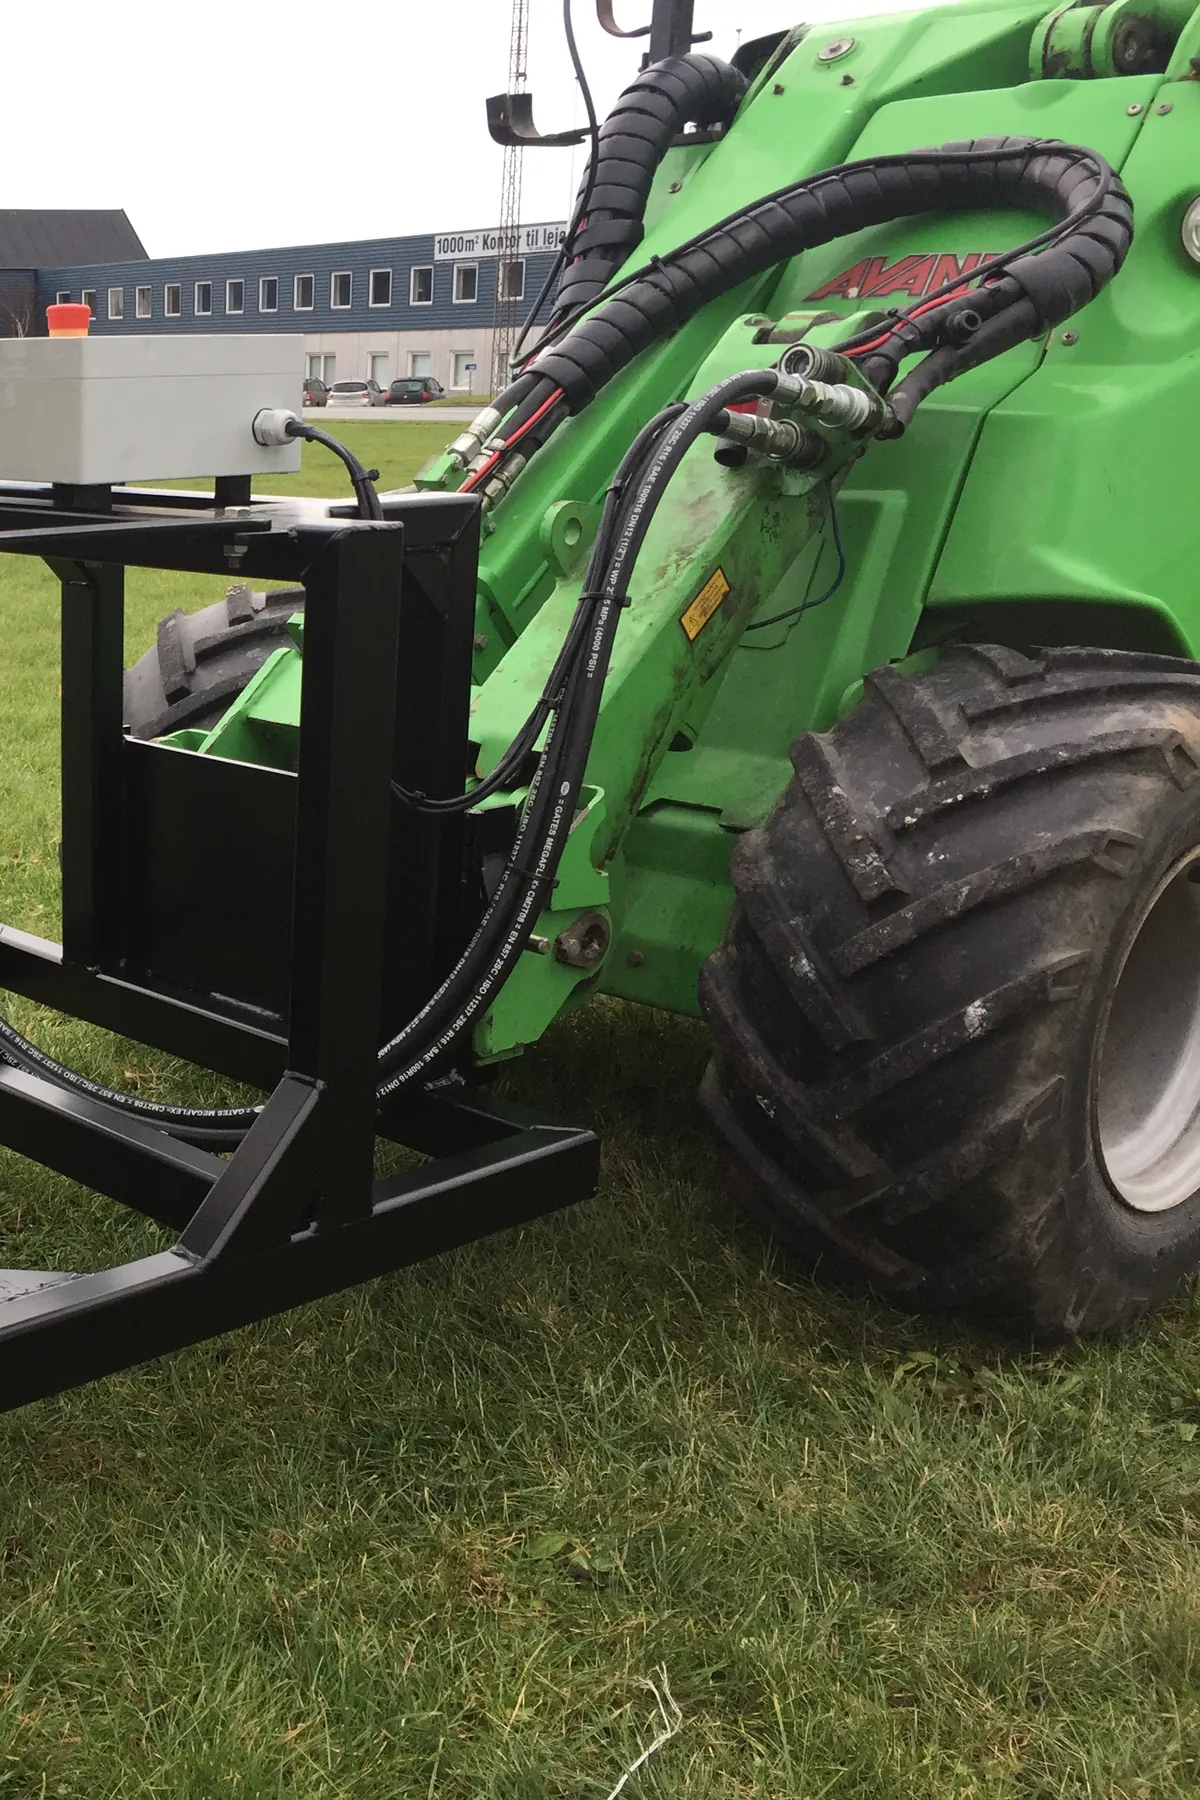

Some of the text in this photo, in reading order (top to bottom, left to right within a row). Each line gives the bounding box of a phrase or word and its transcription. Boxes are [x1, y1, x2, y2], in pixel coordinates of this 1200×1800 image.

[526, 229, 538, 246] til
[680, 411, 696, 430] 11237
[668, 430, 682, 445] 2SC
[659, 446, 673, 460] R16
[648, 465, 662, 483] SAE
[634, 484, 652, 513] 100R16
[624, 514, 640, 537] DN12
[610, 570, 620, 584] WP
[598, 606, 610, 625] MPa
[592, 626, 604, 651] (4000
[586, 652, 598, 671] PSI)
[548, 806, 563, 836] GATES
[516, 890, 535, 922] CM2T08
[508, 930, 518, 944] EN
[500, 944, 512, 958] 857
[490, 958, 504, 976] 2SC
[479, 980, 492, 994] ISO
[464, 994, 482, 1016] 11237
[452, 1015, 467, 1031] 2SC
[14, 1038, 29, 1050] R16
[440, 1030, 456, 1044] R16
[2, 1053, 18, 1066] 2SC
[28, 1048, 43, 1060] 2SC
[422, 1046, 440, 1062] SAE
[42, 1058, 62, 1074] 11237
[398, 1060, 424, 1082] 100R16
[64, 1072, 77, 1082] ISO
[82, 1081, 98, 1092] 2SC
[98, 1088, 112, 1098] 857
[380, 1079, 400, 1096] DN12
[114, 1094, 126, 1103] EN
[134, 1100, 164, 1112] CM2T08
[218, 1108, 244, 1116] GATES
